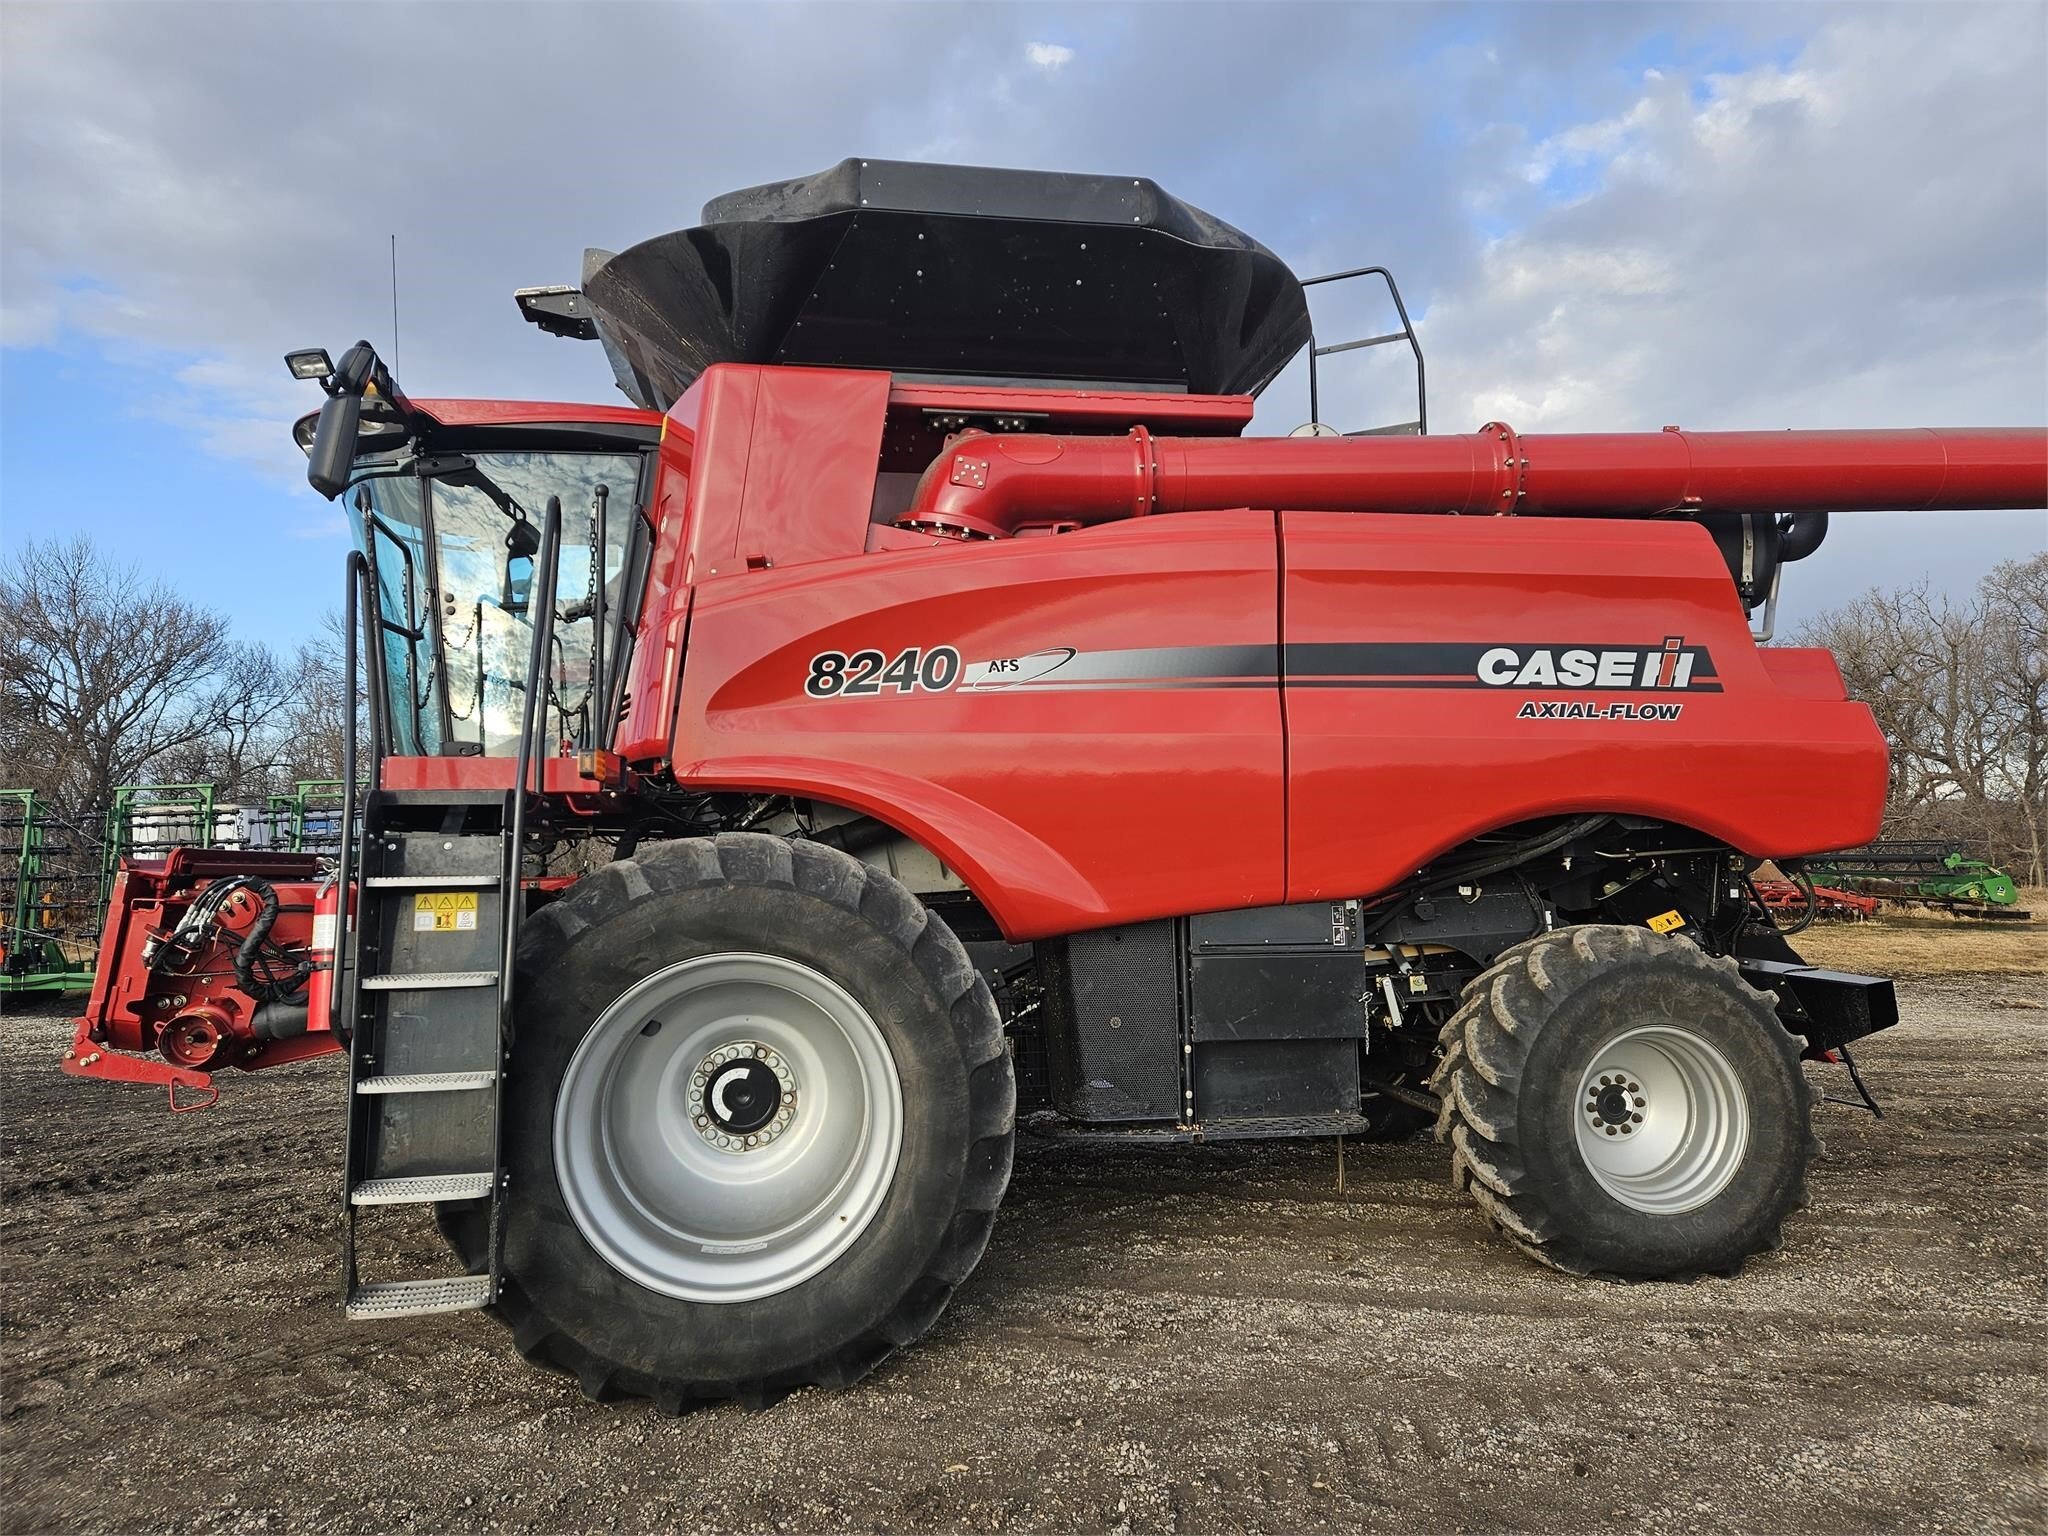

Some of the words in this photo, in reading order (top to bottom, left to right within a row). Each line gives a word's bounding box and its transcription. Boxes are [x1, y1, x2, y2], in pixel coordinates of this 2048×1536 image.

[805, 646, 960, 698] 8240
[988, 658, 1020, 673] AFS
[1477, 647, 1638, 686] CASE
[1517, 702, 1682, 721] AXIAL-FLOW
